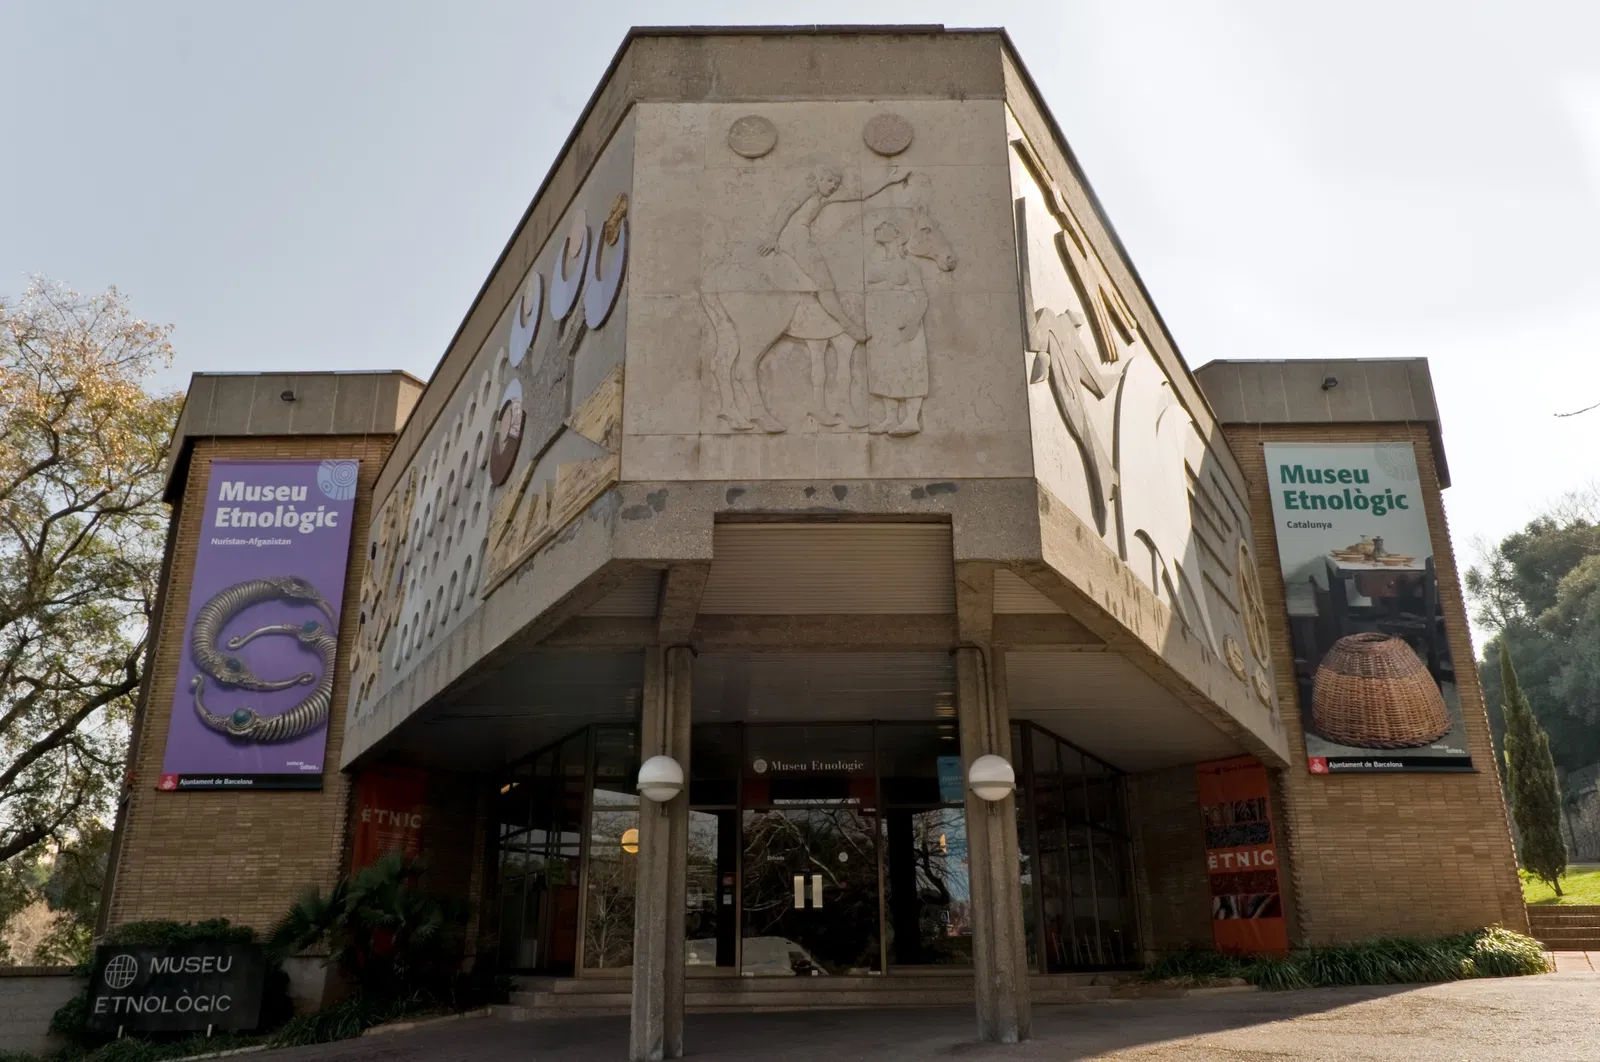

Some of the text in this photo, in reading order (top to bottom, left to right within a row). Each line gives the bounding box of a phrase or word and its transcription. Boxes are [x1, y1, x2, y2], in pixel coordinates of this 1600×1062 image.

[1280, 464, 1370, 484] Museu
[219, 481, 307, 501] Museu
[1283, 488, 1409, 516] Etnològic
[215, 505, 338, 533] Etnològic
[1287, 520, 1333, 530] Catalunya
[211, 537, 291, 547] Nuristan-Afganistan
[772, 760, 807, 771] Museu
[1329, 761, 1363, 769] Ajuntament
[180, 778, 214, 786] Ajuntament
[149, 955, 233, 974] MUSEU
[94, 988, 232, 1014] ETNOLÒGIC
